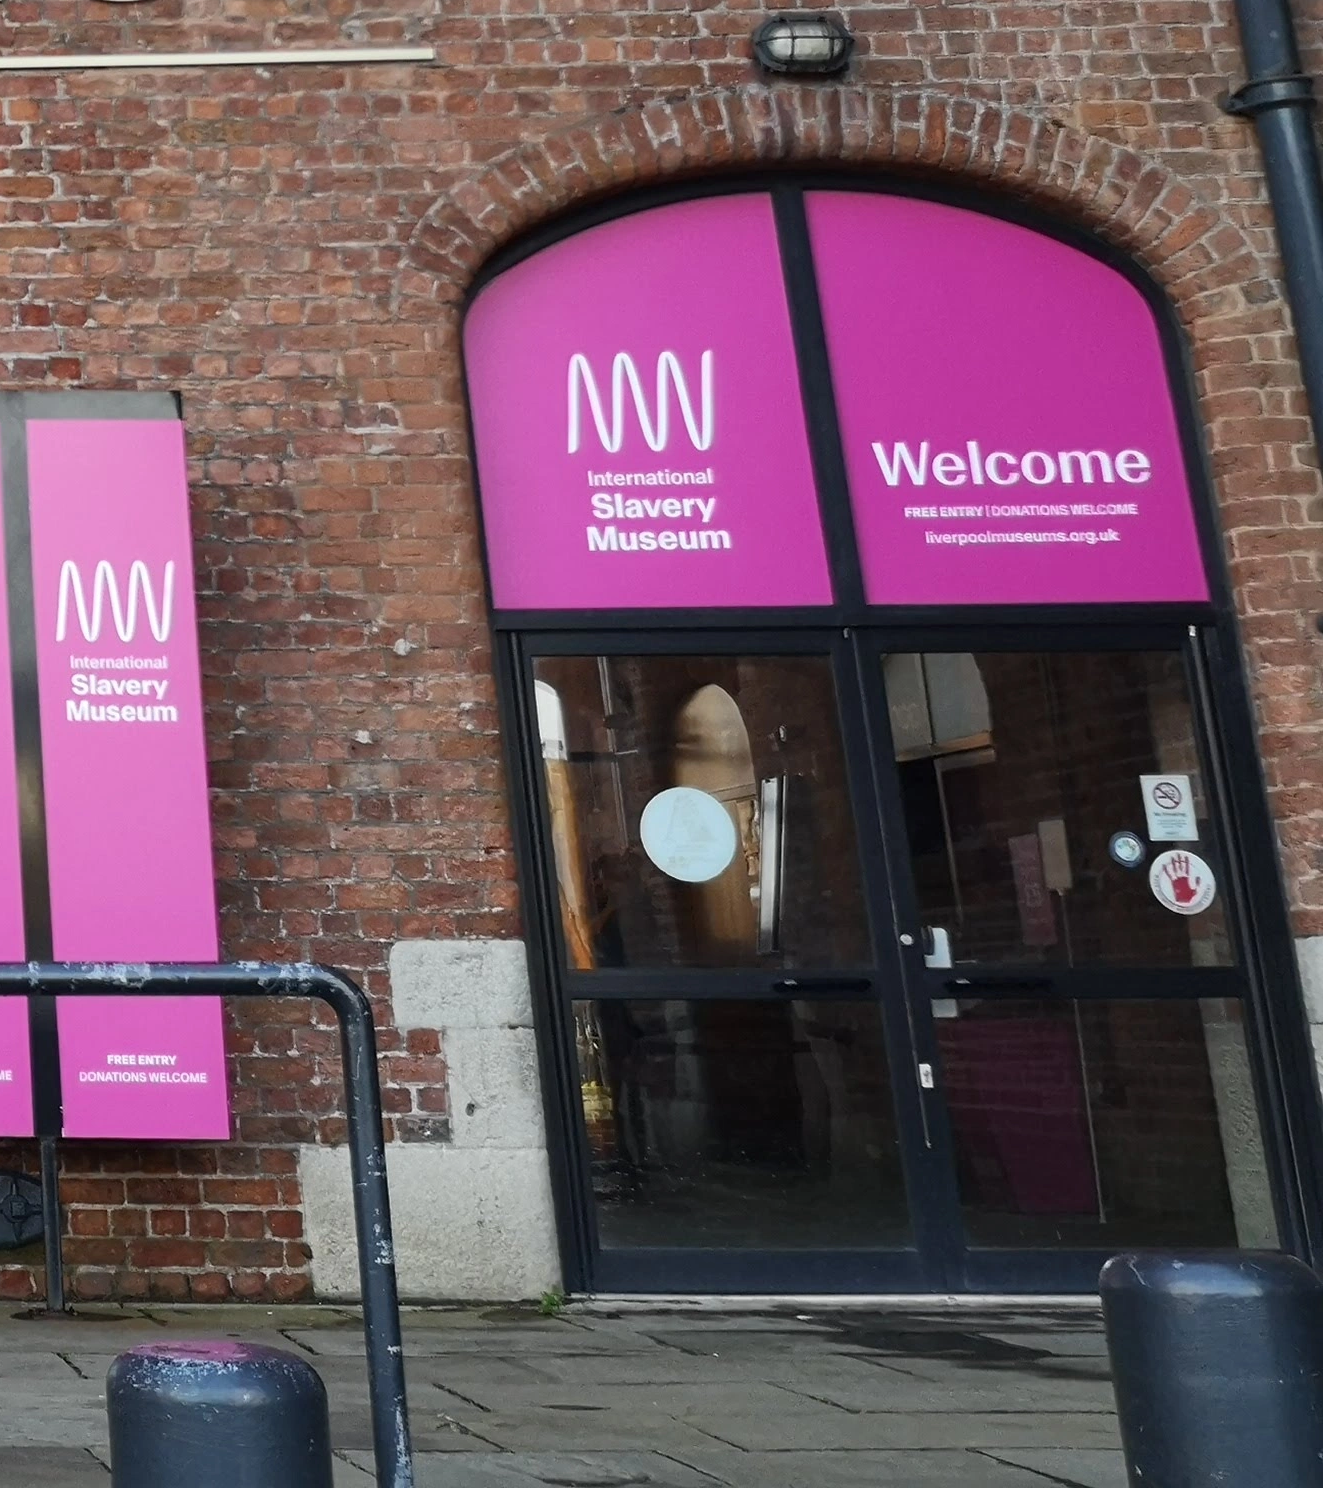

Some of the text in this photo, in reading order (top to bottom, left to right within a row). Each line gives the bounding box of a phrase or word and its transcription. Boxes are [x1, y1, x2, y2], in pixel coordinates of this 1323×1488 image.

[872, 441, 1150, 486] Welcome
[588, 468, 713, 486] International
[591, 493, 715, 522] Slavery
[905, 507, 938, 517] FREE
[940, 506, 983, 517] ENTRY
[991, 505, 1069, 516] DONATIONS
[1069, 504, 1138, 515] WELCOME
[587, 525, 731, 551] Museum
[925, 529, 1120, 546] liverpoolmuseums.org.uk
[70, 656, 168, 669] International
[72, 674, 168, 700] Slavery
[67, 700, 177, 721] Museum
[107, 1055, 176, 1065] FREE ENTRY
[80, 1072, 207, 1083] DONATIONS WELCOME
